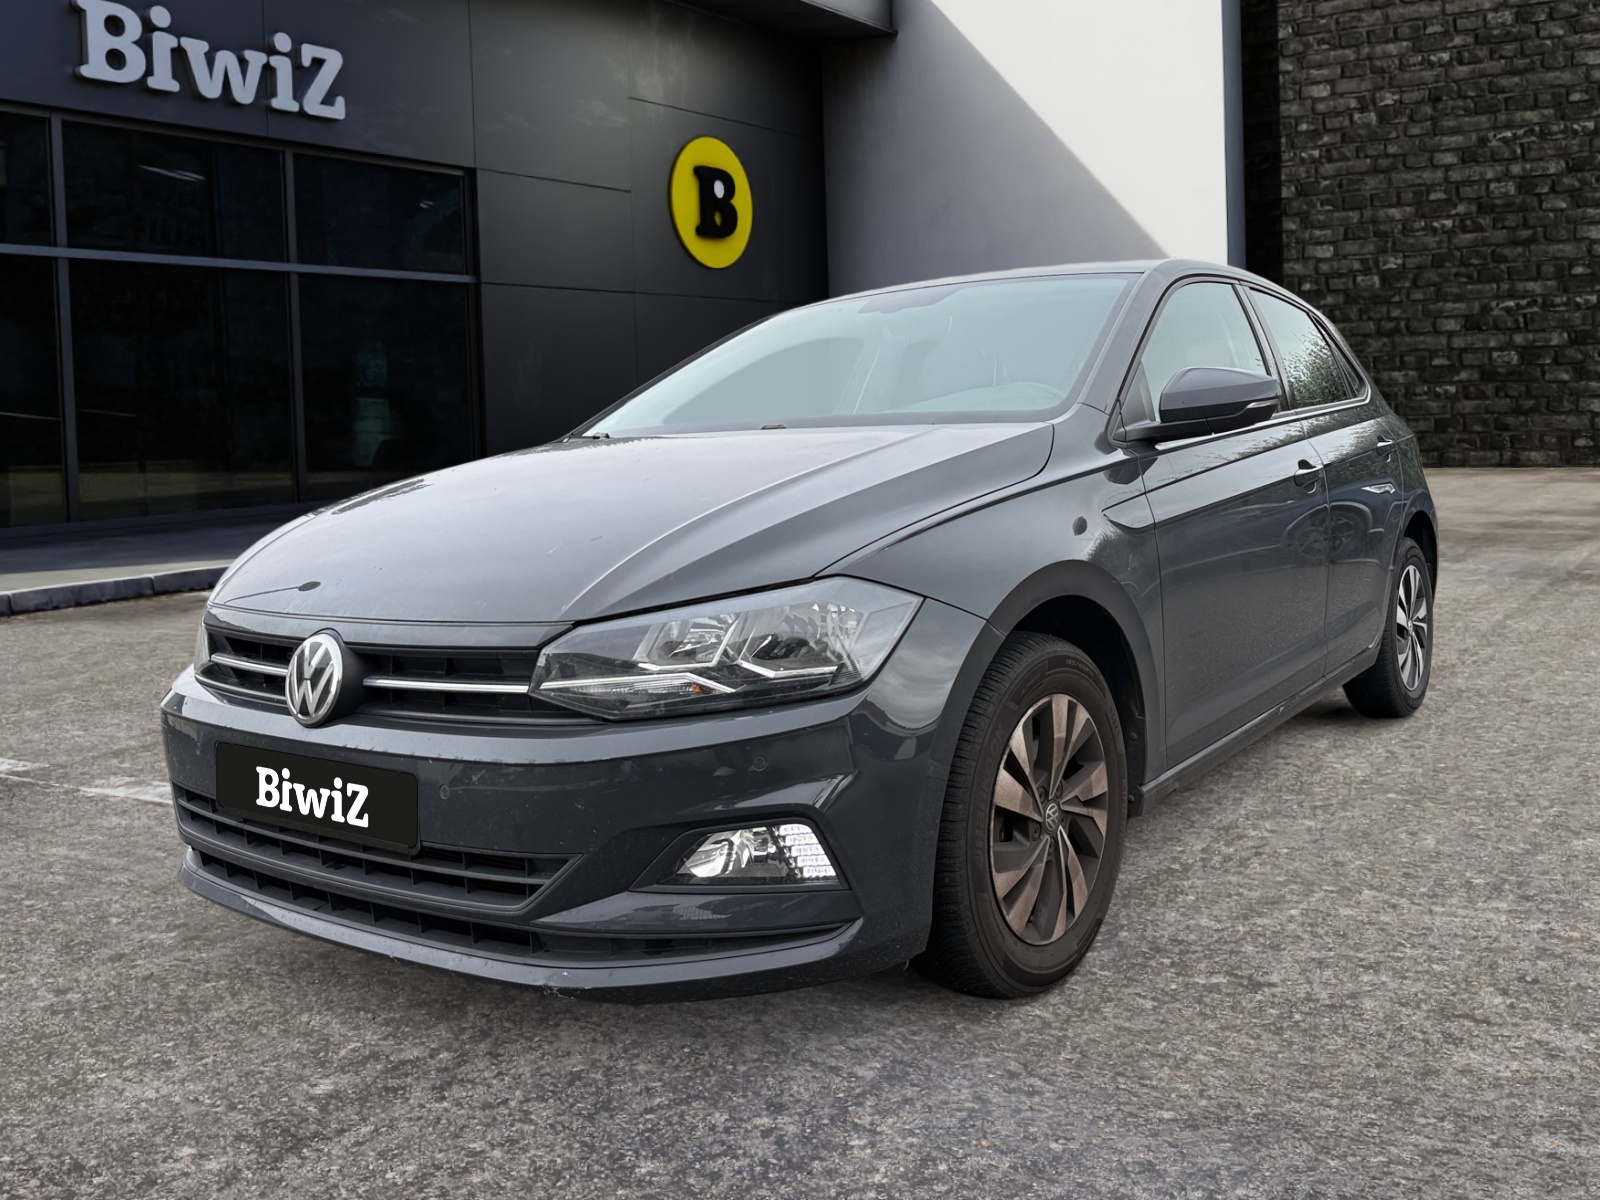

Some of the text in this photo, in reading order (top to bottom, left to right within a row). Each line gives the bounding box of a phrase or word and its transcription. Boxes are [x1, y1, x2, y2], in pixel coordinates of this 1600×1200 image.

[75, 0, 346, 120] BiwiZ
[693, 165, 738, 239] B
[256, 766, 369, 828] BiwiZ
